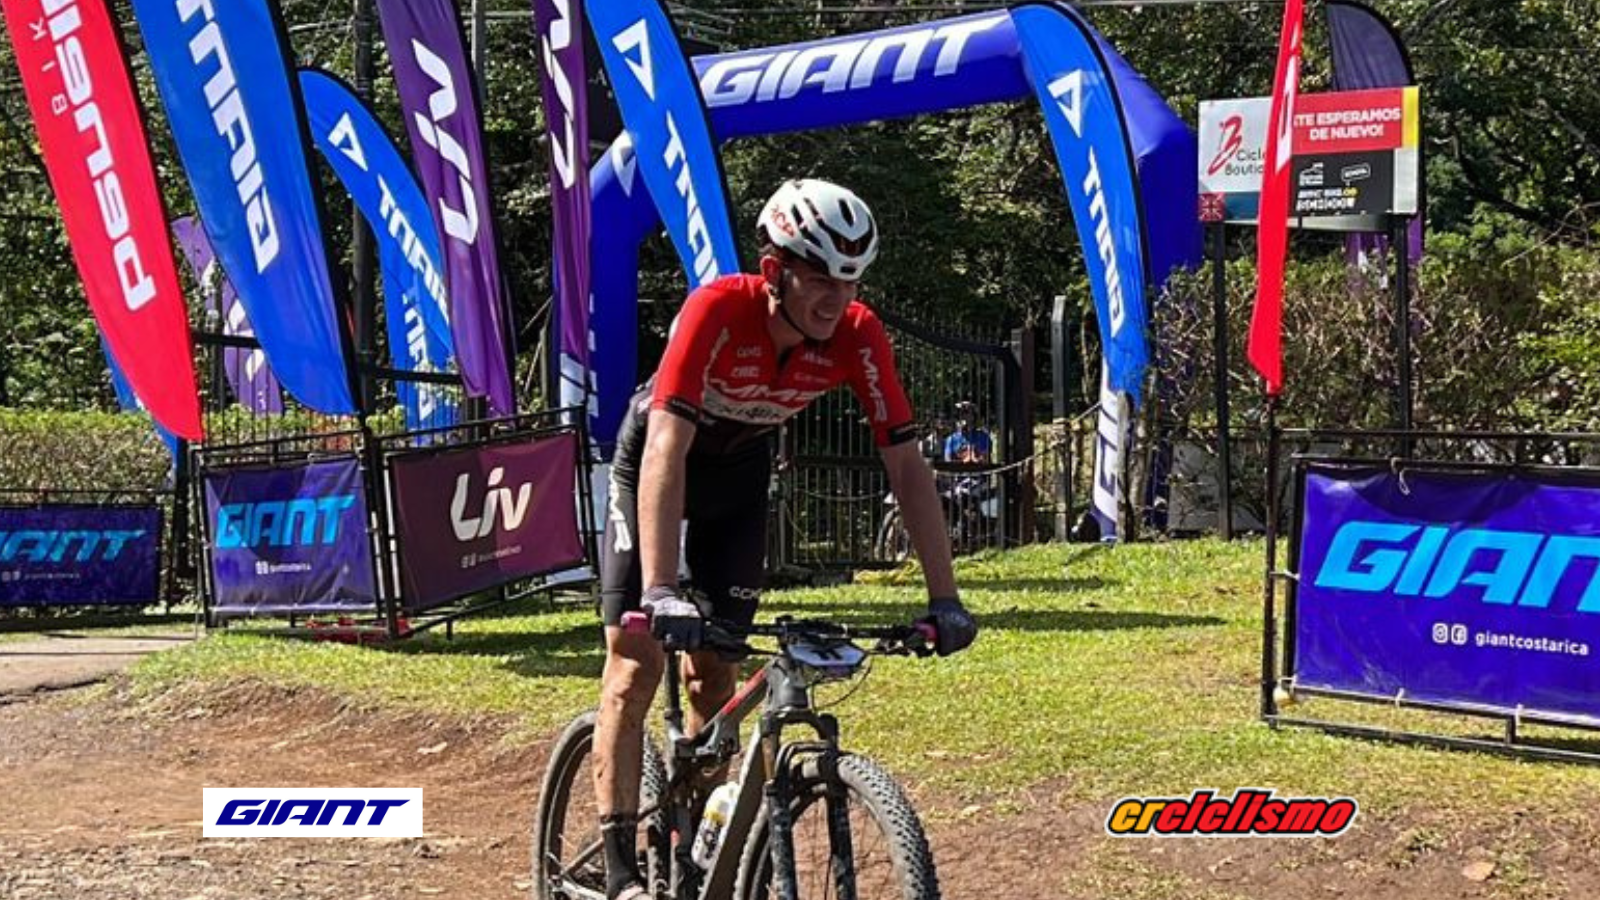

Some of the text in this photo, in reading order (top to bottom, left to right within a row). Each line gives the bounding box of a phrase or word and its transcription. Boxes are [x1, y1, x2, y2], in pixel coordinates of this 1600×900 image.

[700, 16, 1008, 108] GIANT
[412, 39, 478, 244] Liv
[1310, 123, 1384, 140] DE NUEVO!
[1316, 107, 1402, 126] ESPERAMOS
[215, 495, 355, 548] GIANT
[450, 467, 532, 541] Liv
[1475, 631, 1590, 656] giantcostarica
